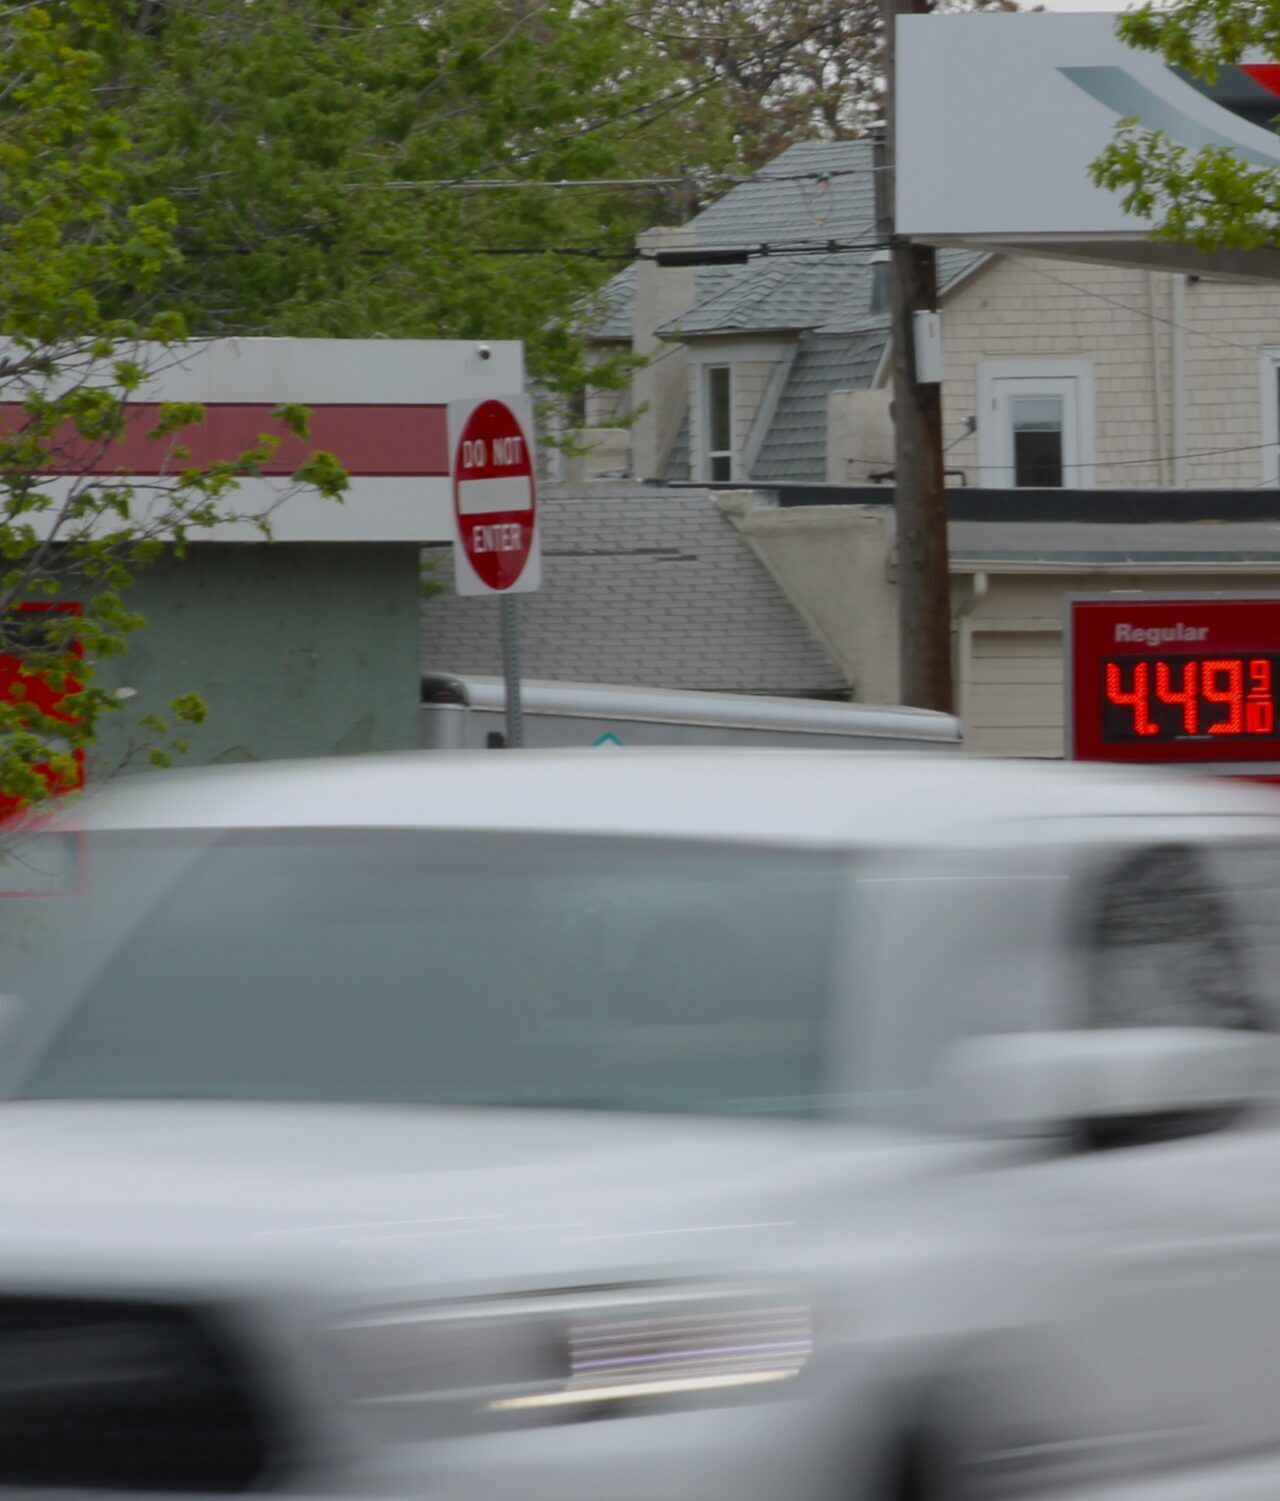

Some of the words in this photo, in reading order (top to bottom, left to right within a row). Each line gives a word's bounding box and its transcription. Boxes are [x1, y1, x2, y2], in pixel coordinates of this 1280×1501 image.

[463, 439, 487, 468] DO
[492, 436, 522, 467] NOT
[473, 524, 522, 553] ENTER
[1114, 623, 1209, 646] Regular
